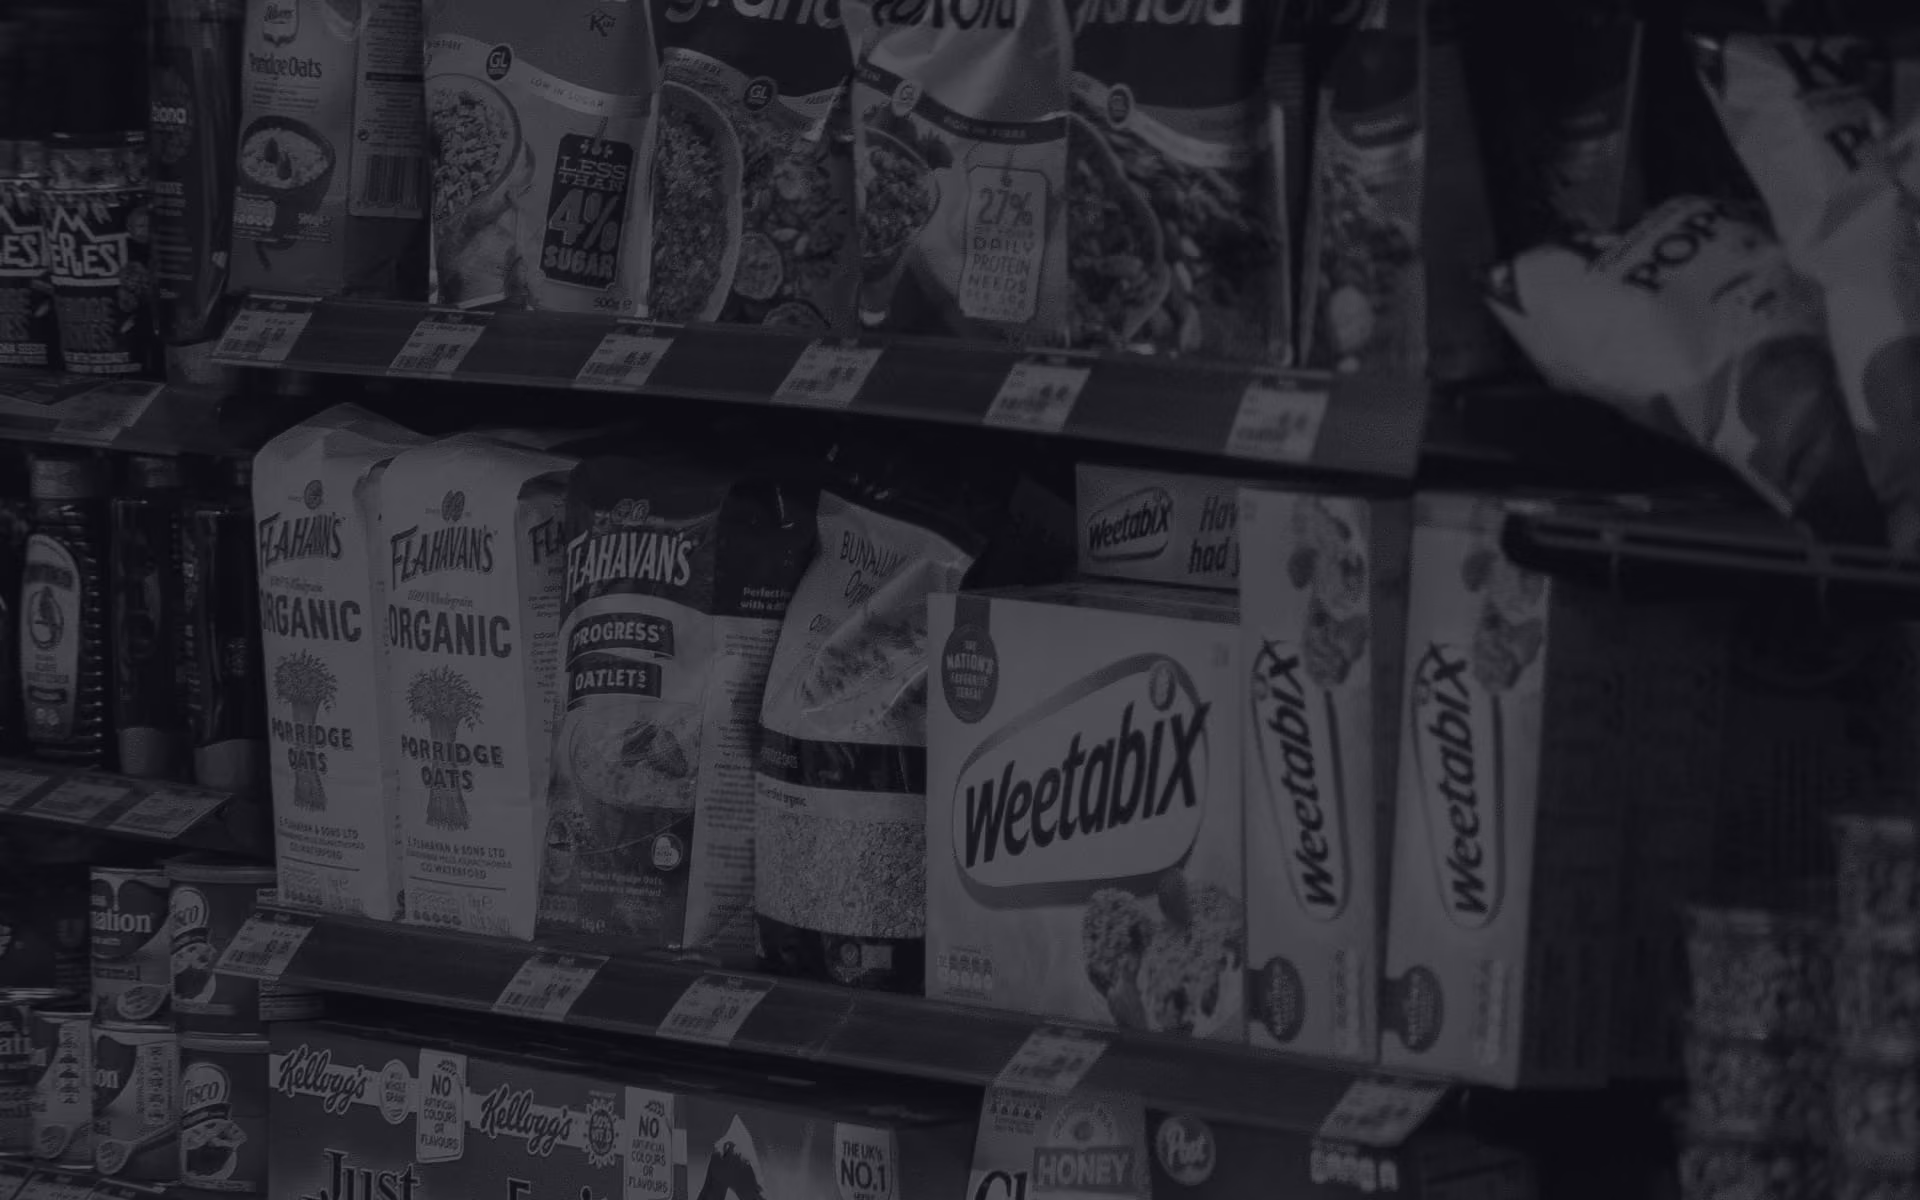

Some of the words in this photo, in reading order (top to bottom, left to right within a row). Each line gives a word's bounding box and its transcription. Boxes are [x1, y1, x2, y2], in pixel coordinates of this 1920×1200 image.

[288, 57, 322, 79] Oats
[558, 171, 625, 192] THAN
[559, 155, 627, 181] LESS
[549, 187, 620, 252] 4%
[976, 187, 1033, 226] 27%
[543, 244, 616, 279] SUGAR
[1088, 498, 1173, 550] Weetabix
[1200, 494, 1240, 532] Hav
[391, 523, 495, 592] FLAHAVAN'S
[565, 529, 692, 604] FLAHAVAN'S
[1188, 536, 1231, 574] had
[260, 589, 362, 642] RGANIC
[388, 603, 513, 658] ORGANIC
[573, 621, 660, 651] PROGRESS
[575, 668, 647, 690] OATLETS
[271, 717, 354, 751] PORRIDGE
[401, 734, 504, 768] PORRIDGE
[287, 747, 328, 775] OATS
[1262, 637, 1337, 906] Weetabix
[1426, 641, 1489, 915] Weetabix
[420, 767, 475, 791] OATS
[965, 701, 1212, 868] Weetabix
[278, 1044, 367, 1114] Kellogg's
[431, 1074, 452, 1098] NO
[424, 1108, 457, 1124] COLOURS
[480, 1083, 573, 1157] Kellogg's
[638, 1115, 659, 1139] NO
[420, 1134, 460, 1150] FLAVOURS
[631, 1150, 665, 1168] COLOURS
[843, 1141, 859, 1158] THE
[627, 1176, 668, 1195] FLAVOURS
[841, 1158, 886, 1193] NO.1
[1039, 1153, 1129, 1185] HONEY
